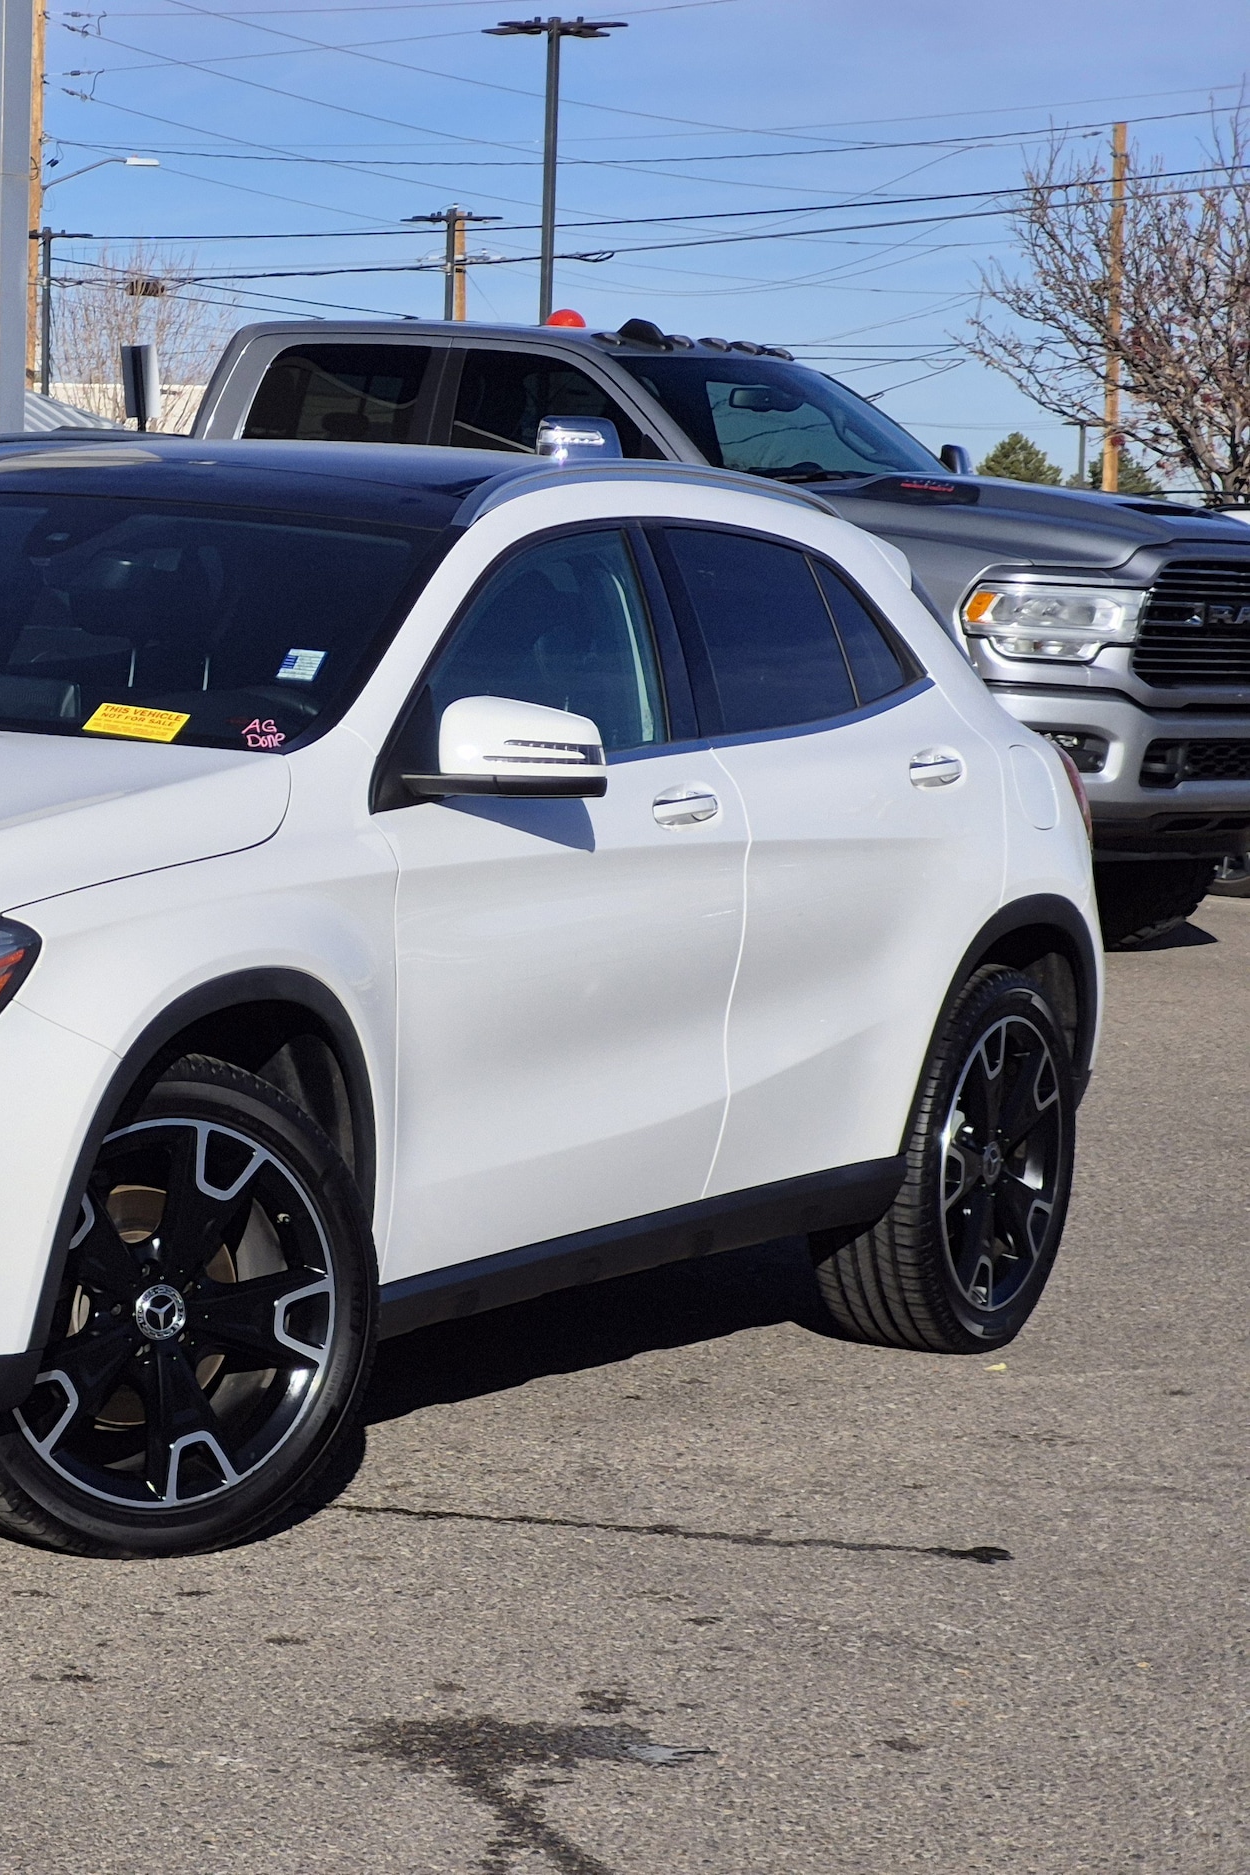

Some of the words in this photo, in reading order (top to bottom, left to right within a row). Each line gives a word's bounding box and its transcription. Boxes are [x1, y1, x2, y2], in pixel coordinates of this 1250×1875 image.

[100, 712, 122, 720] NOT
[148, 718, 177, 727] SALE
[103, 705, 130, 714] THIS
[133, 708, 184, 722] VEHICLE
[241, 718, 277, 734] AG
